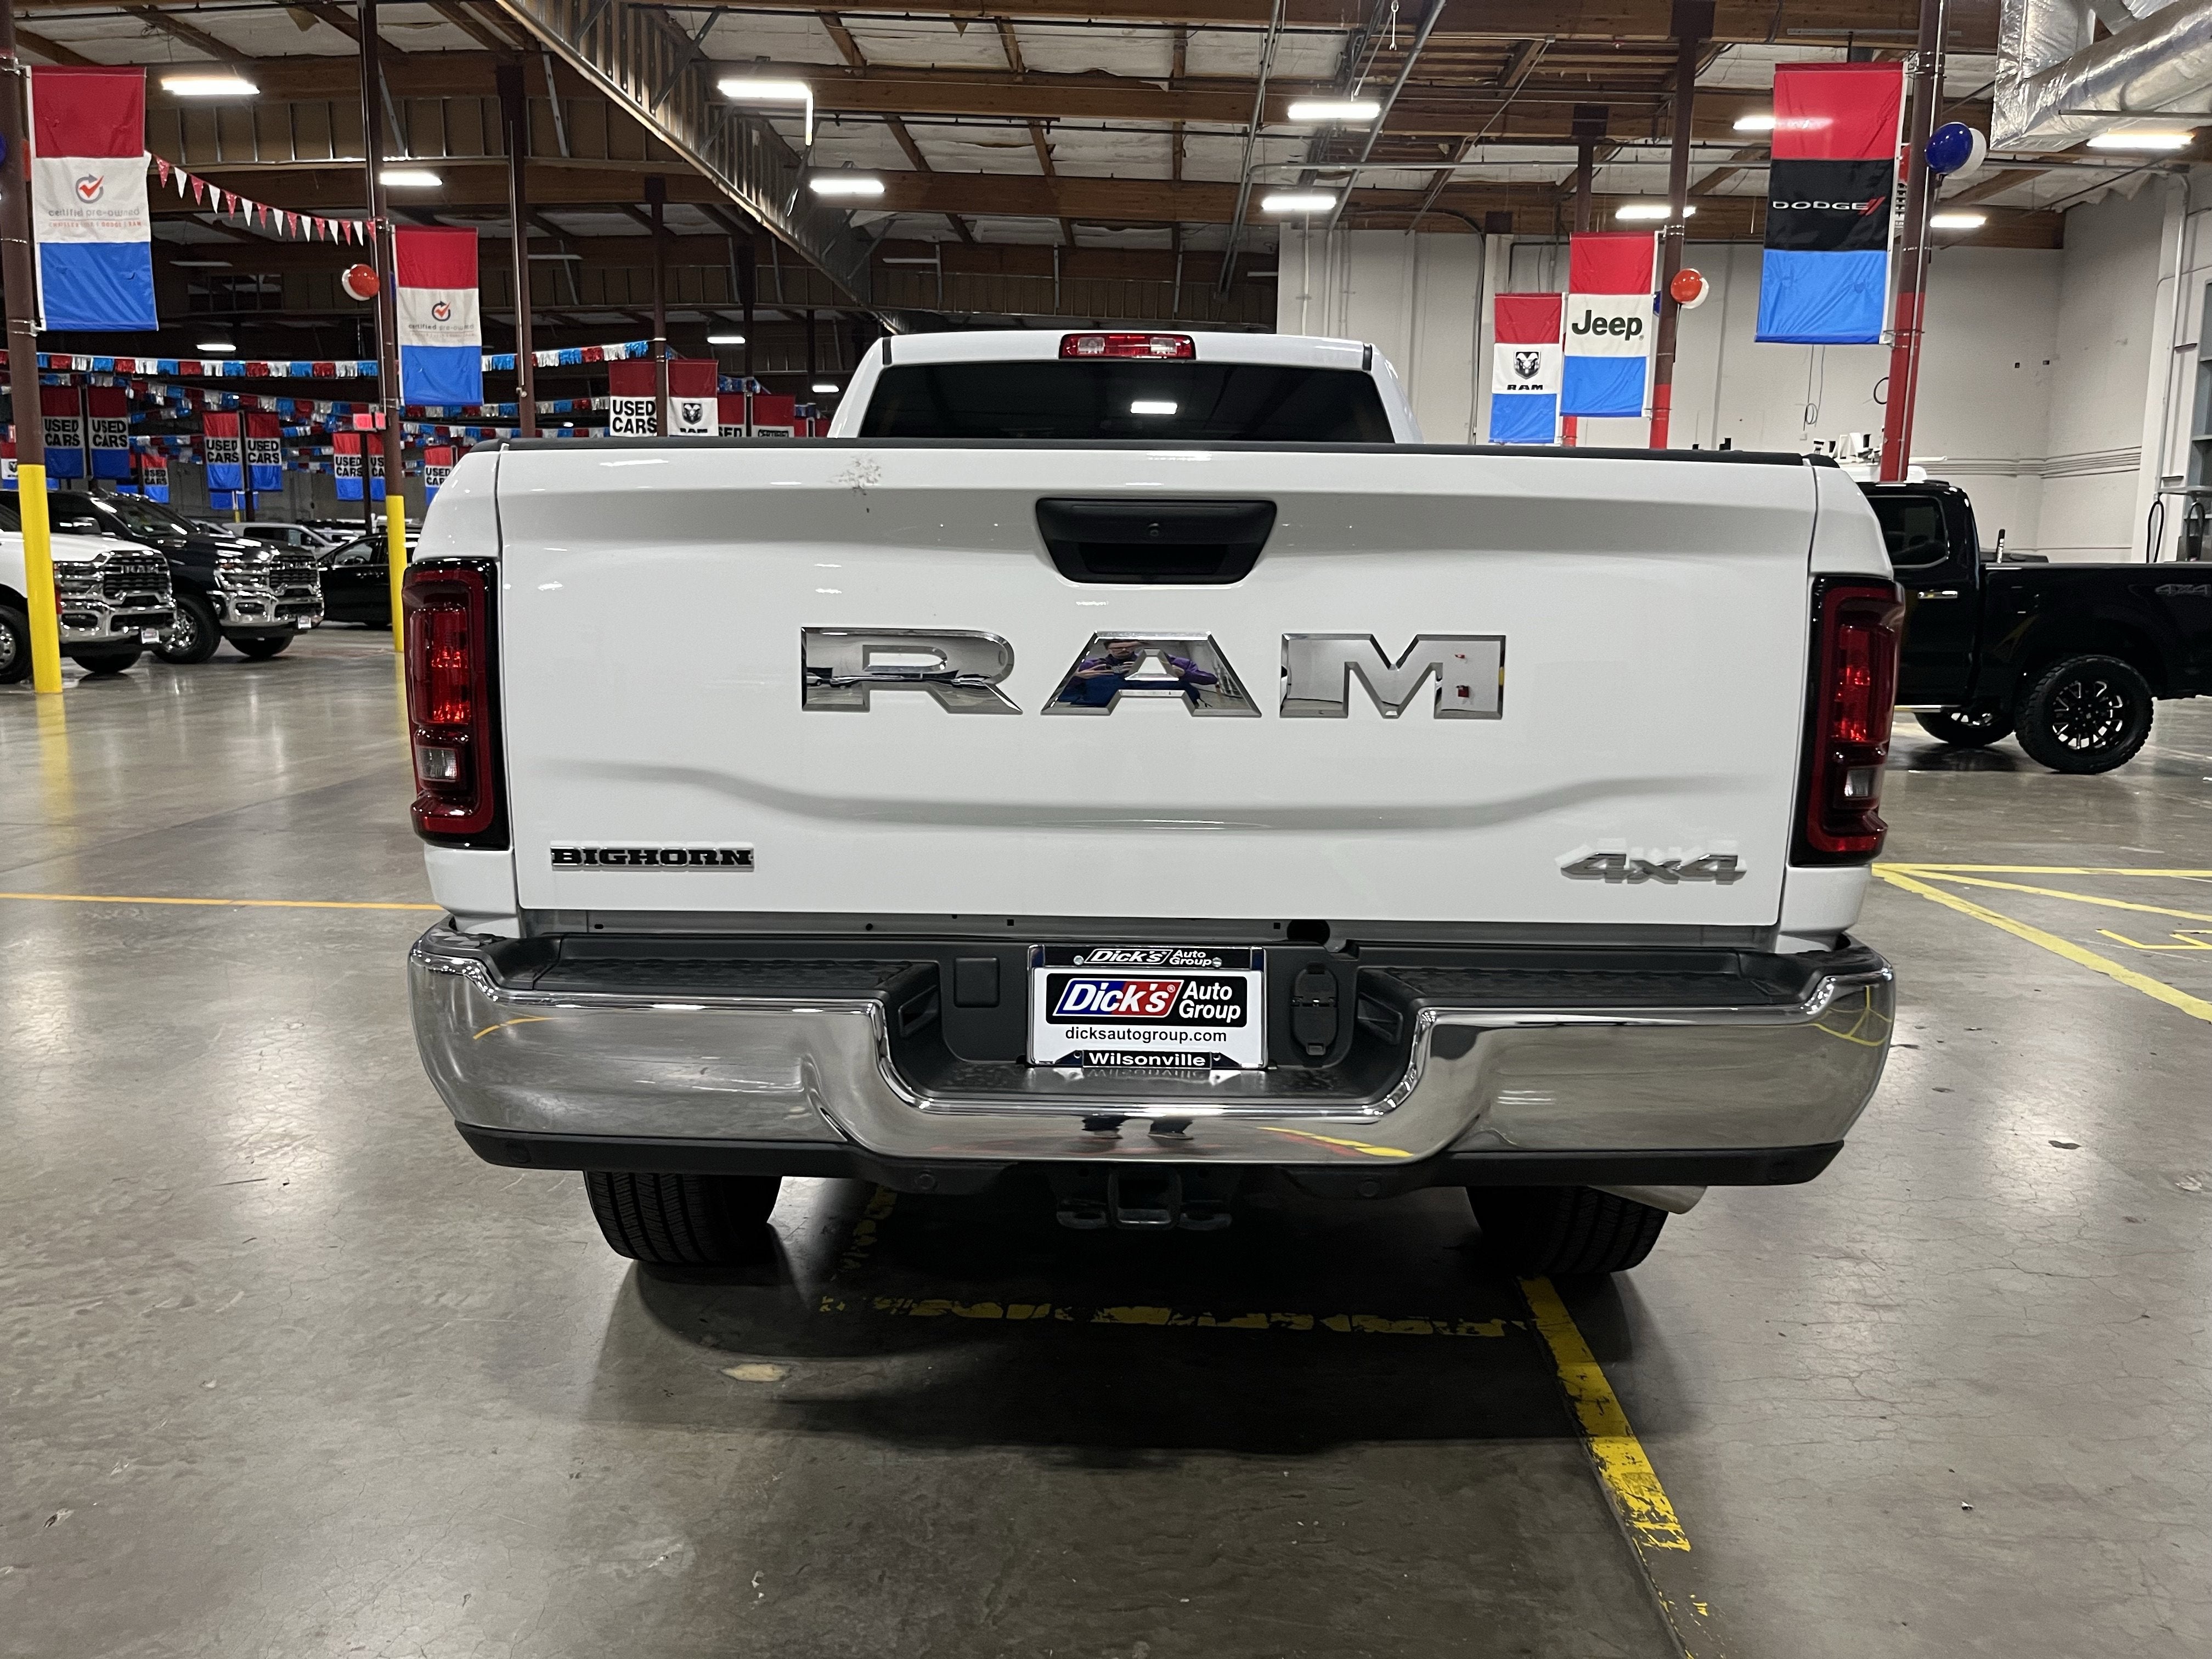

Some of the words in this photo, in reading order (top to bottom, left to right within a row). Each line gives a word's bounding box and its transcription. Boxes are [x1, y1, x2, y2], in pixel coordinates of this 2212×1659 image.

[1773, 201, 1869, 210] DODGE
[1571, 309, 1643, 341] Jeep
[612, 399, 656, 416] USED
[45, 419, 79, 432] USED
[92, 419, 126, 433] USED
[612, 417, 657, 434] CARS
[719, 427, 742, 437] SED
[45, 433, 80, 447] CARS
[93, 434, 128, 448] CARS
[206, 439, 238, 451] USED
[247, 440, 279, 451] USED
[207, 452, 239, 462] CARS
[247, 453, 279, 463] CARS
[335, 456, 361, 466] USED
[370, 457, 384, 466] US
[336, 467, 363, 477] CARS
[426, 467, 450, 476] USED
[426, 477, 445, 486] CAR
[801, 627, 1506, 720] RAM
[550, 846, 754, 871] BIGHORN
[1561, 853, 1747, 885] 4x4
[1090, 950, 1164, 963] Dick's
[1172, 950, 1206, 958] Auto
[1169, 957, 1212, 967] Group
[1182, 981, 1233, 1001] Auto
[1063, 983, 1169, 1013] Dick's
[1178, 1000, 1241, 1023] Group
[1065, 1026, 1227, 1043] dicksautogroup.com
[1088, 1052, 1206, 1067] Wilsonville
